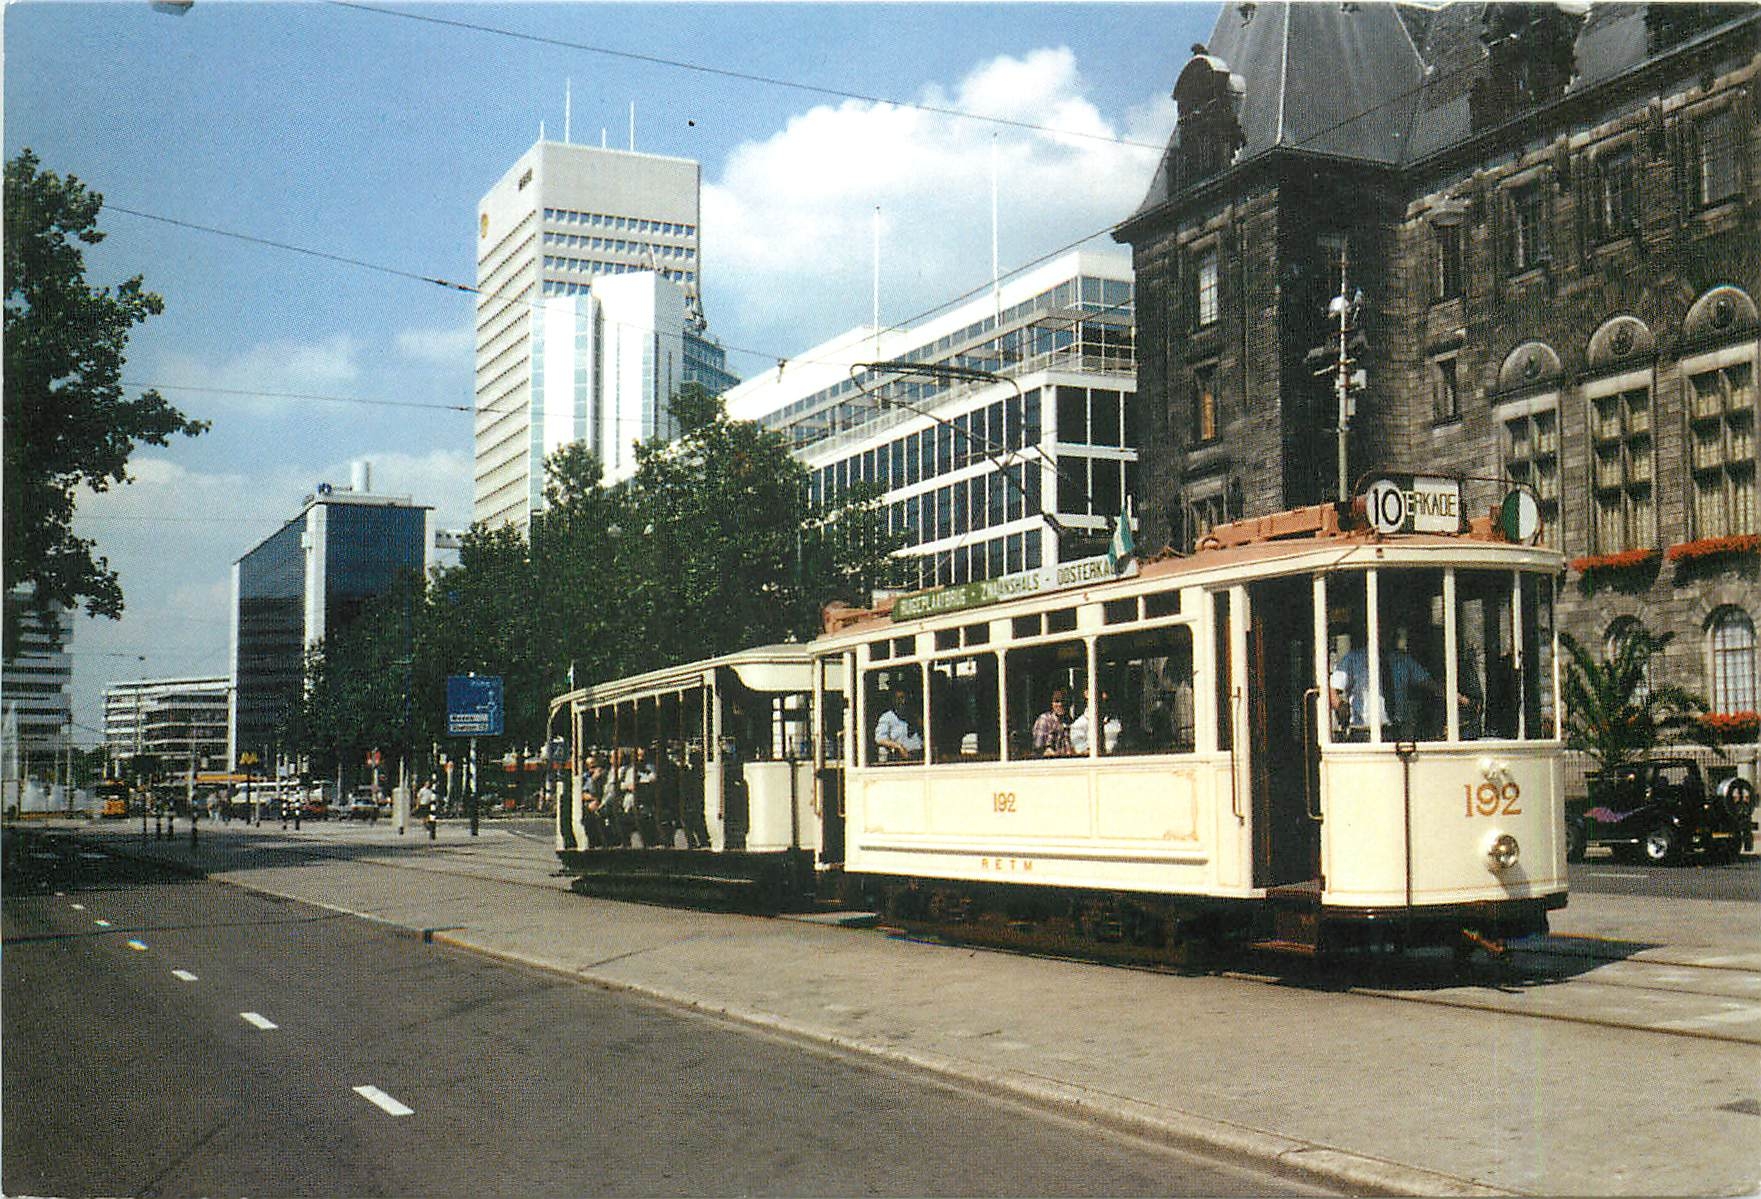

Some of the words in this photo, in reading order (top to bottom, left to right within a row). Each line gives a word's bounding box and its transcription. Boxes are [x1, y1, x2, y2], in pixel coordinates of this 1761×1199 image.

[1373, 488, 1402, 526] 10
[1403, 490, 1457, 518] ERKADE
[993, 791, 1017, 813] 192
[1463, 781, 1522, 818] 192
[981, 857, 1033, 872] RETM
